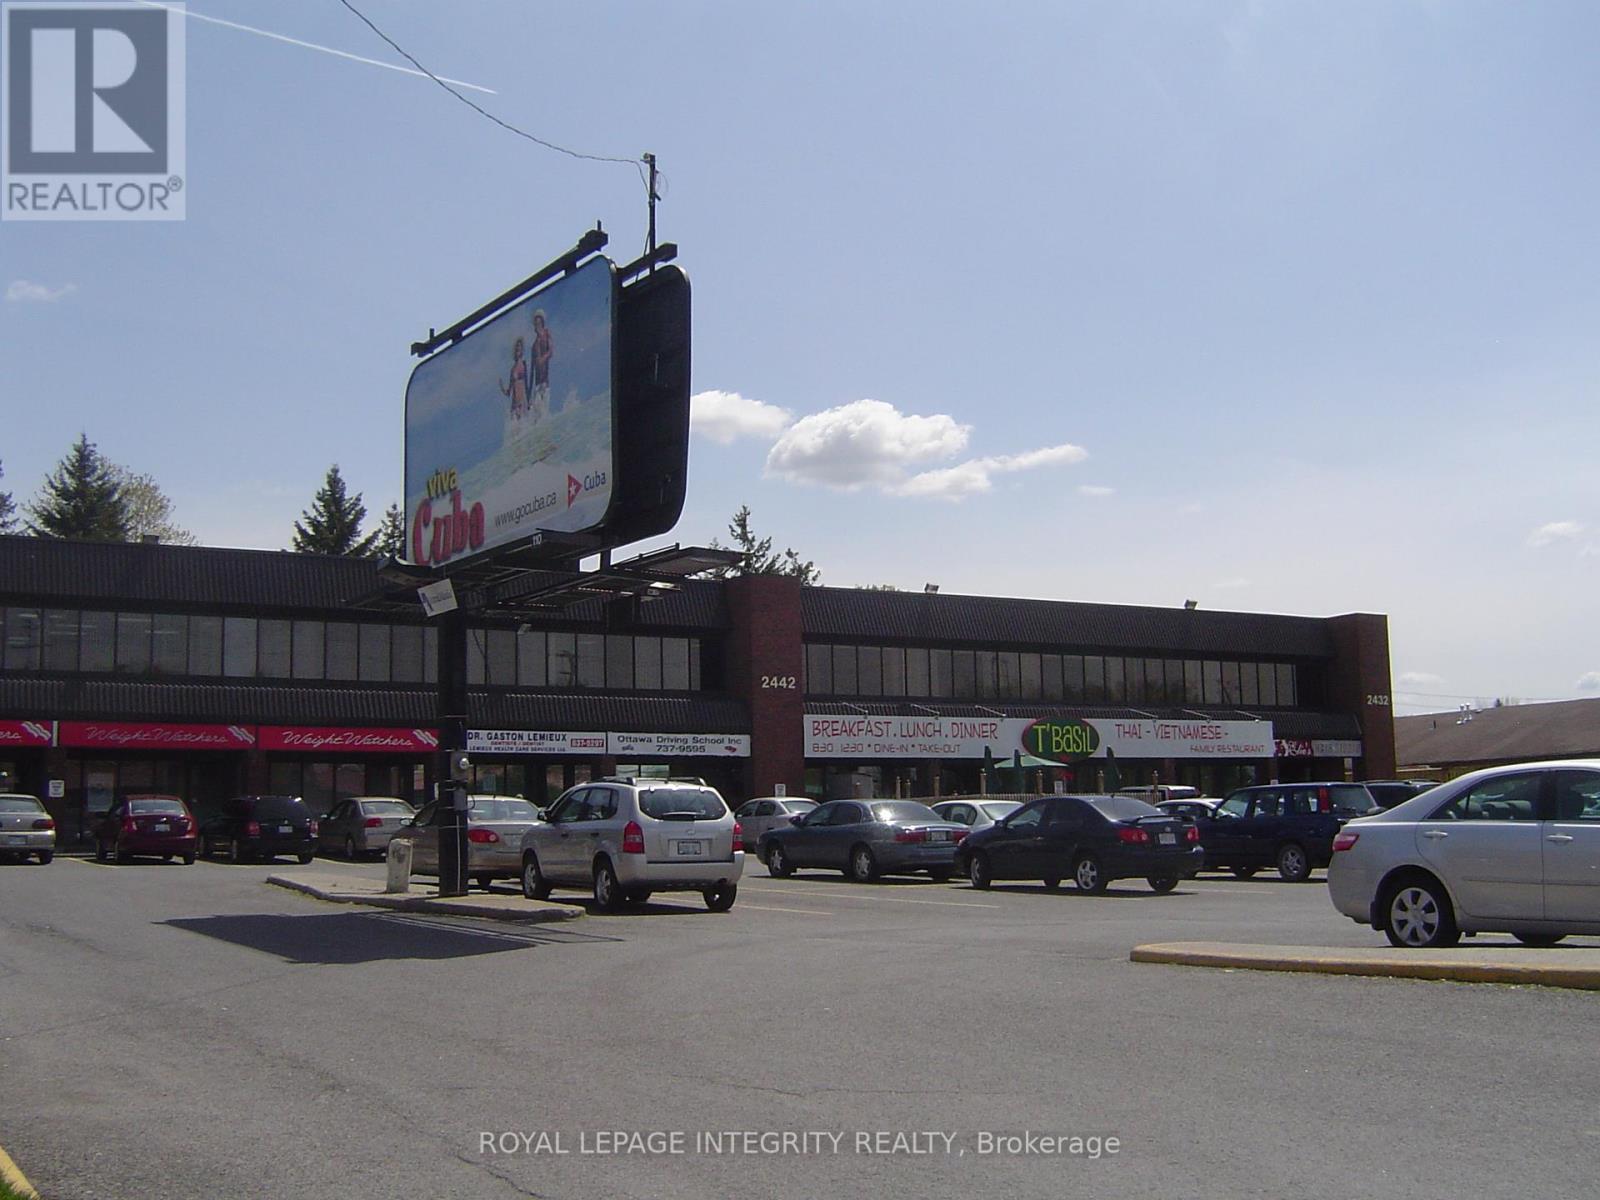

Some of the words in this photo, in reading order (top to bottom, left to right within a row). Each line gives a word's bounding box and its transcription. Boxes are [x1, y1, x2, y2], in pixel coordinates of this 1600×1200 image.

[427, 467, 457, 500] viva
[584, 470, 606, 491] Cuba
[495, 492, 557, 527] www.gocuba.ca
[412, 489, 485, 567] Cuba
[761, 676, 796, 689] 2442
[1367, 694, 1389, 705] 2432
[86, 727, 152, 743] Weight
[152, 728, 228, 742] Watchers
[282, 731, 343, 747] Weight
[343, 732, 413, 746] Watchers
[467, 732, 483, 740] DR.
[487, 732, 524, 741] GASTON
[528, 733, 567, 742] LEMIEUX
[1115, 724, 1142, 739] THAI
[617, 735, 652, 743] Ottawa
[656, 736, 688, 745] Driving
[692, 736, 724, 744] School
[873, 744, 909, 753] DINE-IN
[1190, 745, 1215, 753] FAMILY
[1217, 745, 1265, 754] RESTAURANT
